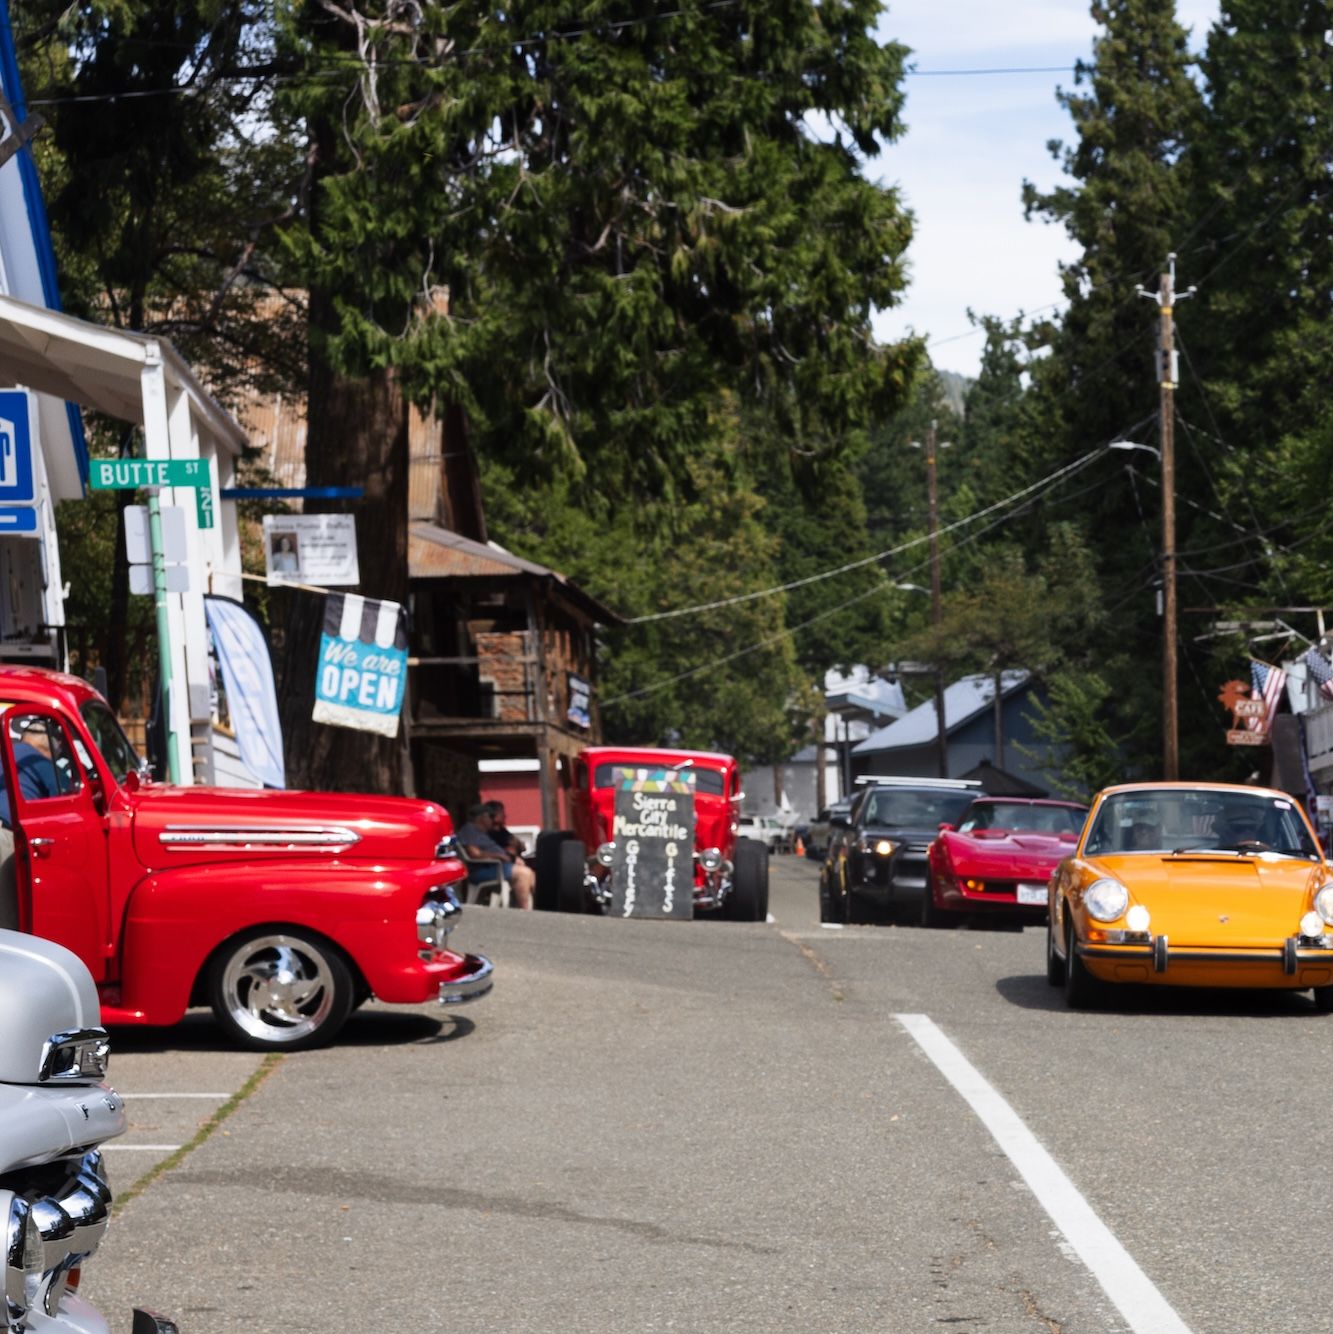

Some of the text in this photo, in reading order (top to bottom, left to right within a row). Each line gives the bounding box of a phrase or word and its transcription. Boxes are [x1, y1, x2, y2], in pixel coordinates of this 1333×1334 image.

[100, 462, 199, 485] BUTTE ST
[200, 486, 212, 528] 21
[324, 639, 401, 676] We are
[321, 665, 399, 709] OPEN
[632, 792, 677, 812] Sierra
[614, 816, 688, 840] Mercantile
[640, 809, 668, 826] City
